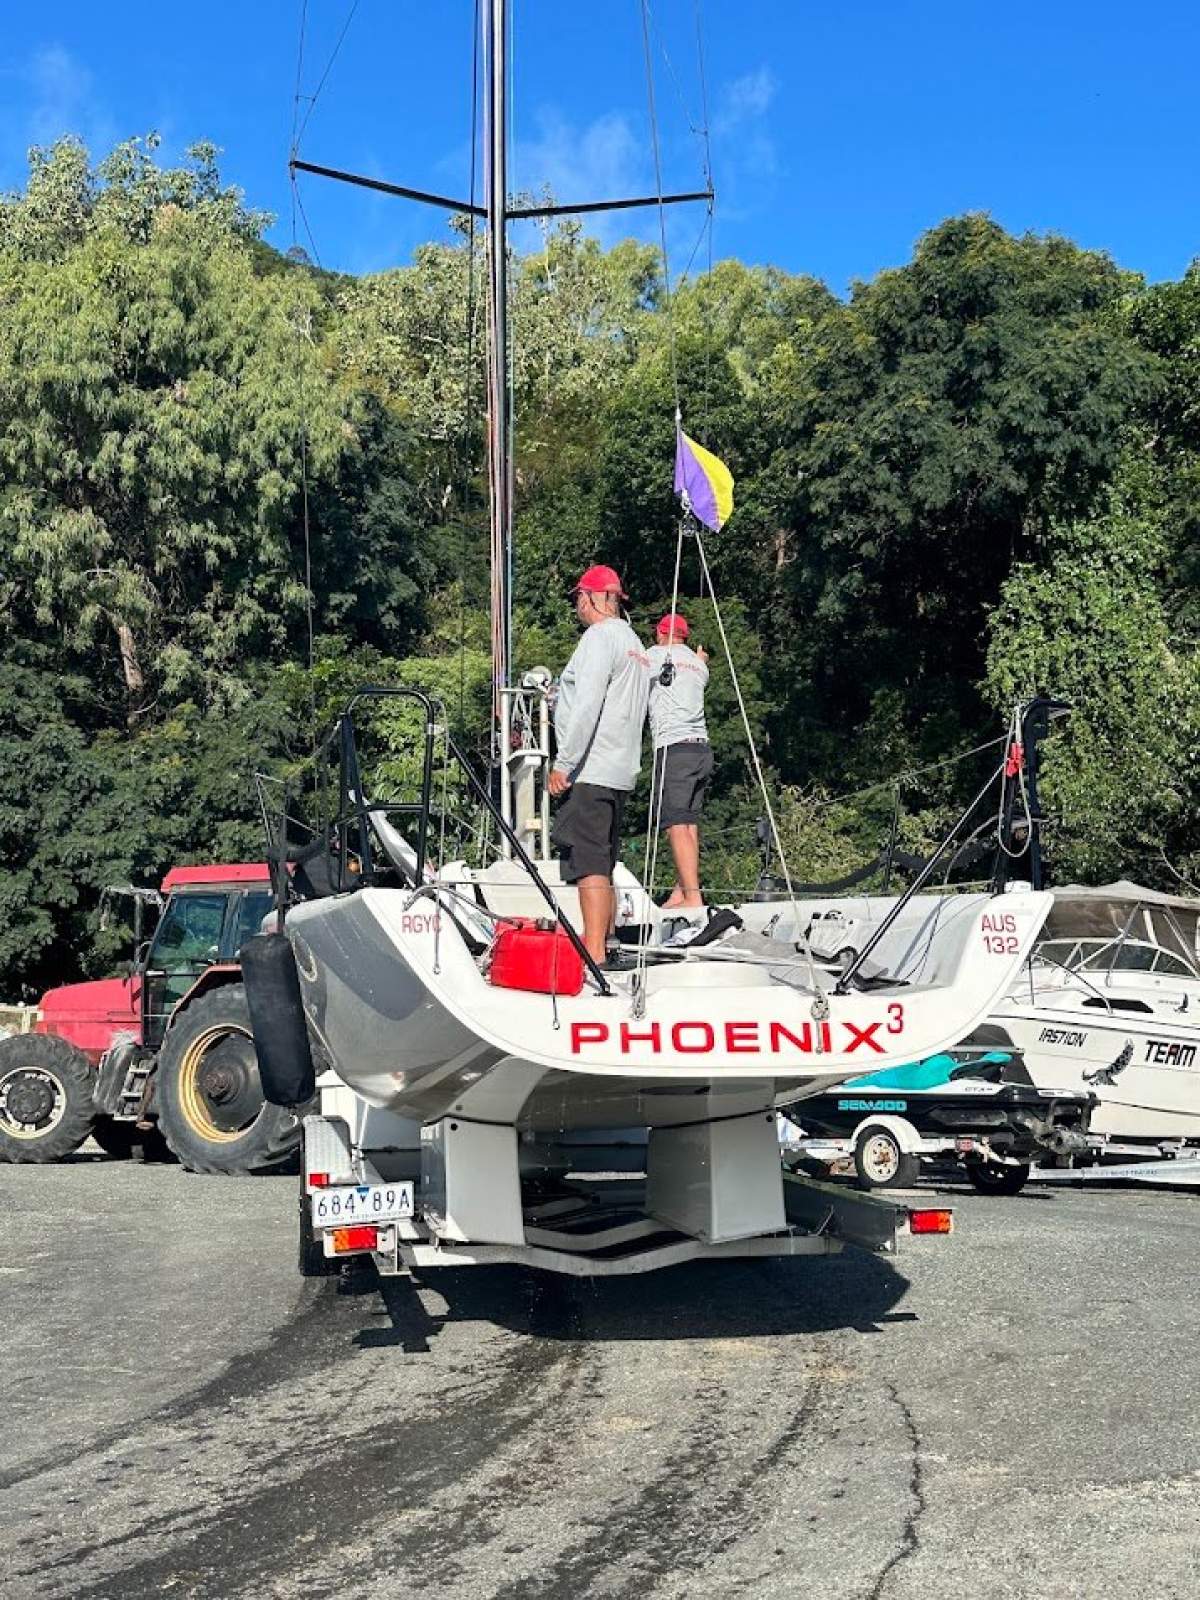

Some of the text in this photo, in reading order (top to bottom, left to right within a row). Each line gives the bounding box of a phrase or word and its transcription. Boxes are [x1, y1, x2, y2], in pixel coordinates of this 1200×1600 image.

[402, 914, 442, 933] RGYC
[981, 914, 1016, 933] AUS
[983, 936, 1019, 955] 132
[570, 1021, 887, 1054] PHOENIX
[1144, 1039, 1198, 1068] TEAM
[317, 1193, 355, 1217] 684
[373, 1188, 410, 1212] 89A
